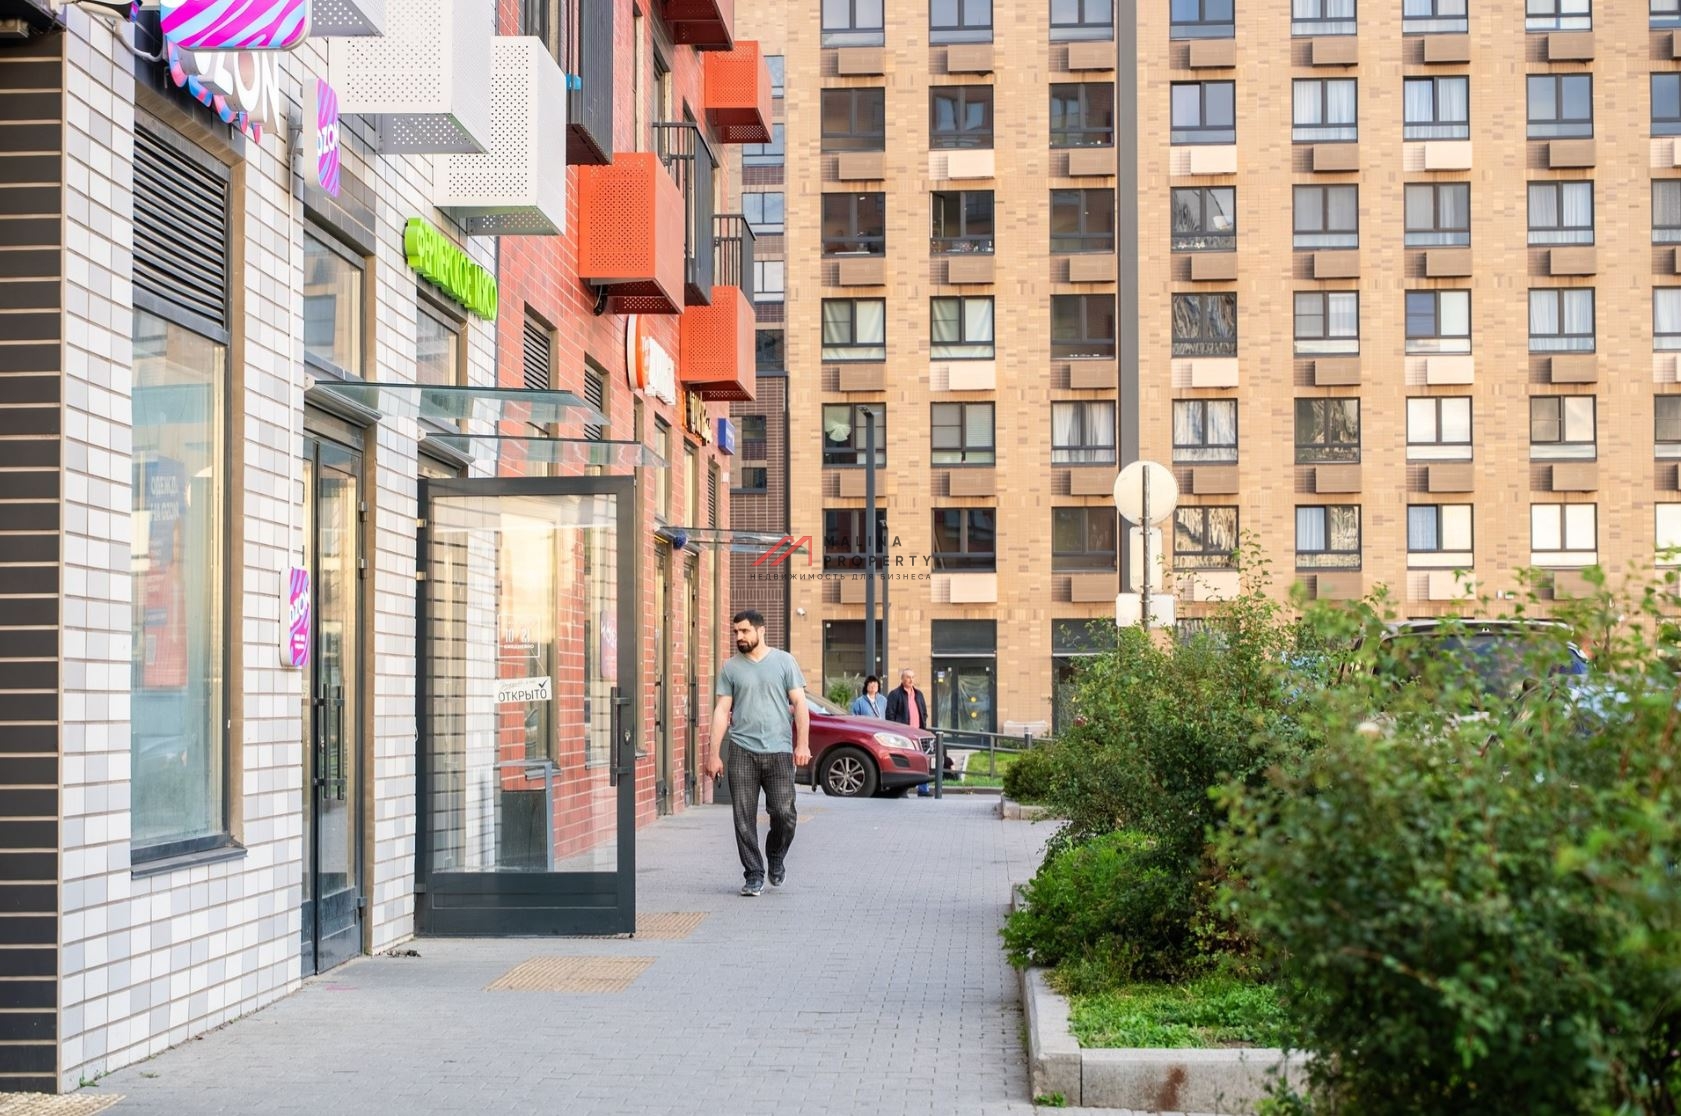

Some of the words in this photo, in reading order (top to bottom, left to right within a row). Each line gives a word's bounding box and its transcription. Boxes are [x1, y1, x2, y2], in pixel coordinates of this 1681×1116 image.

[195, 51, 280, 134] ZON
[317, 121, 339, 157] OZON
[289, 589, 310, 627] OZON
[498, 688, 547, 703] ОТКРЫТО
